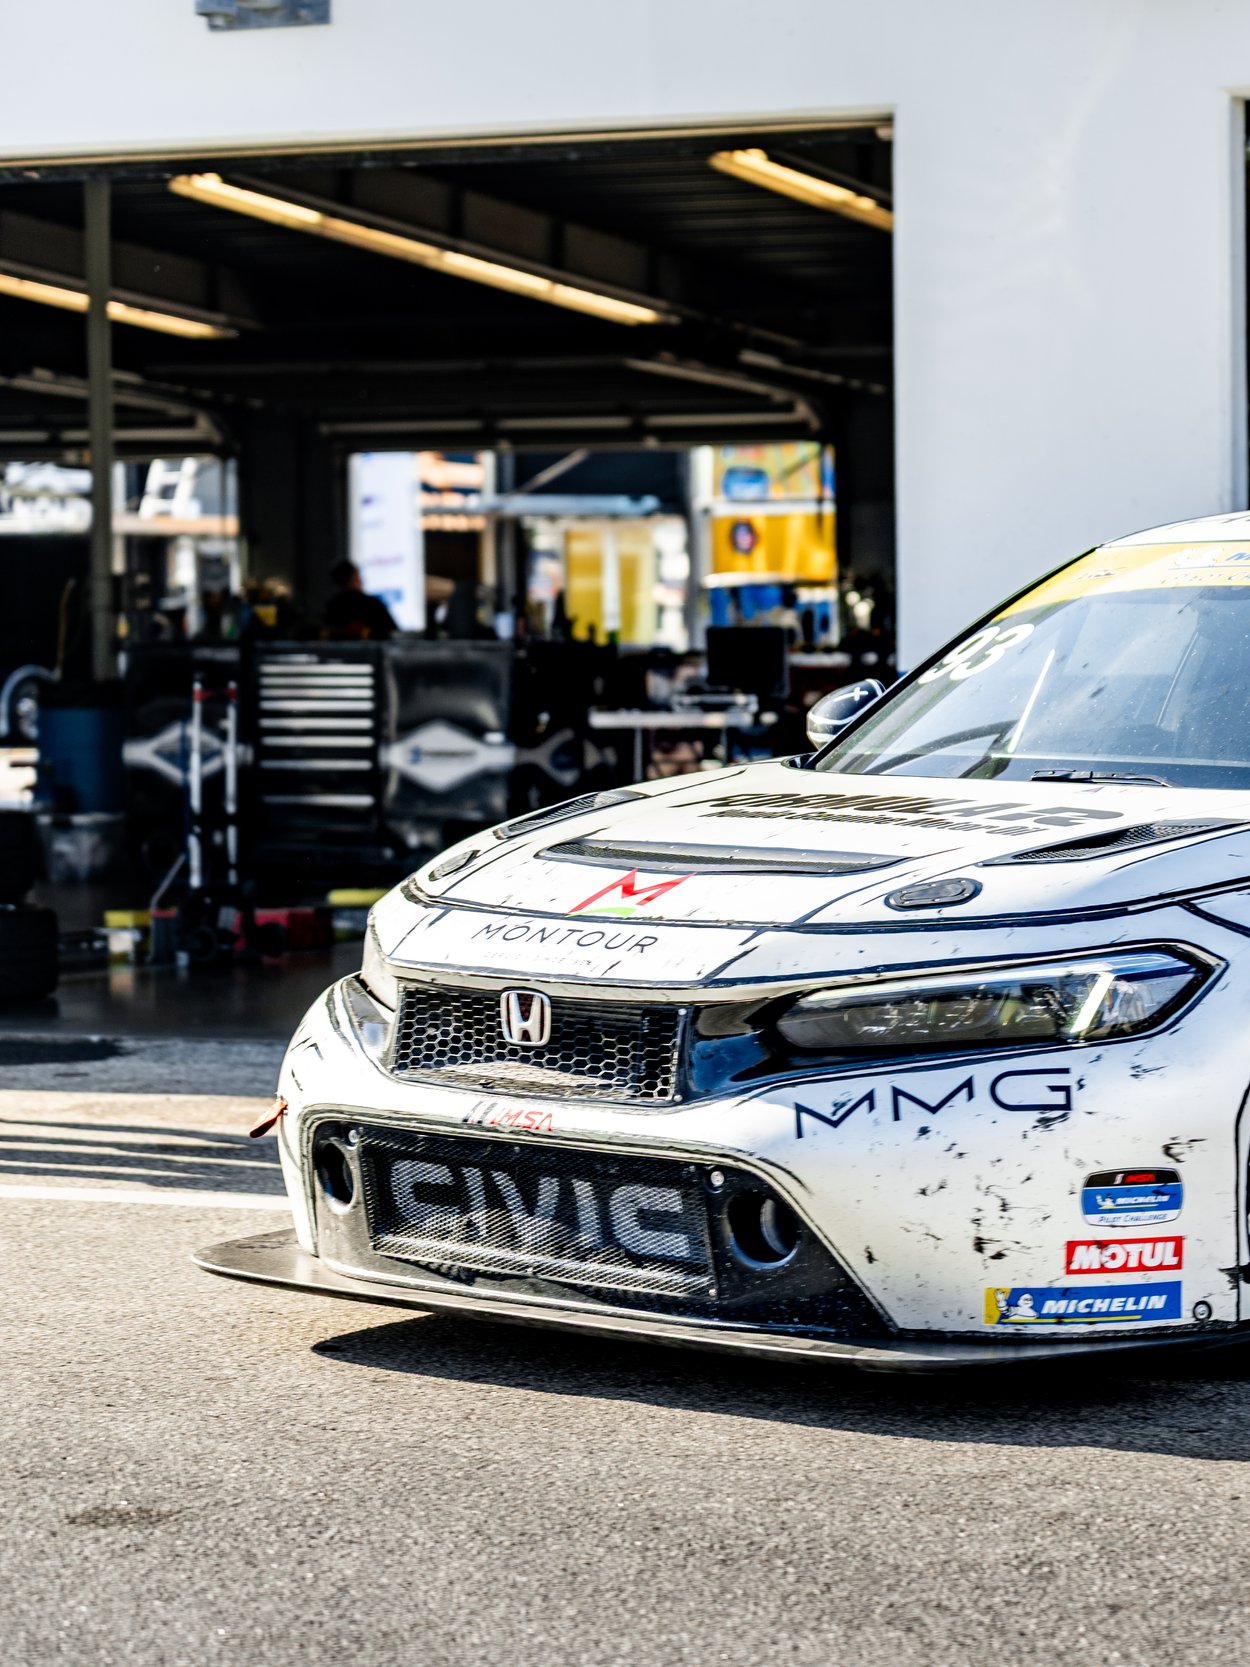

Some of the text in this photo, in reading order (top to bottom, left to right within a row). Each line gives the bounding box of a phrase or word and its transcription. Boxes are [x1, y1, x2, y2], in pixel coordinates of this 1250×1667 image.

[918, 623, 1035, 684] 93
[900, 816, 995, 832] Motor
[471, 924, 658, 953] MONTOUR
[794, 1067, 1072, 1139] MMG
[490, 1107, 553, 1131] IMSA
[390, 1160, 691, 1259] CIVIC
[1069, 1241, 1179, 1271] MOTUL
[1041, 1295, 1168, 1314] MICHELIN
